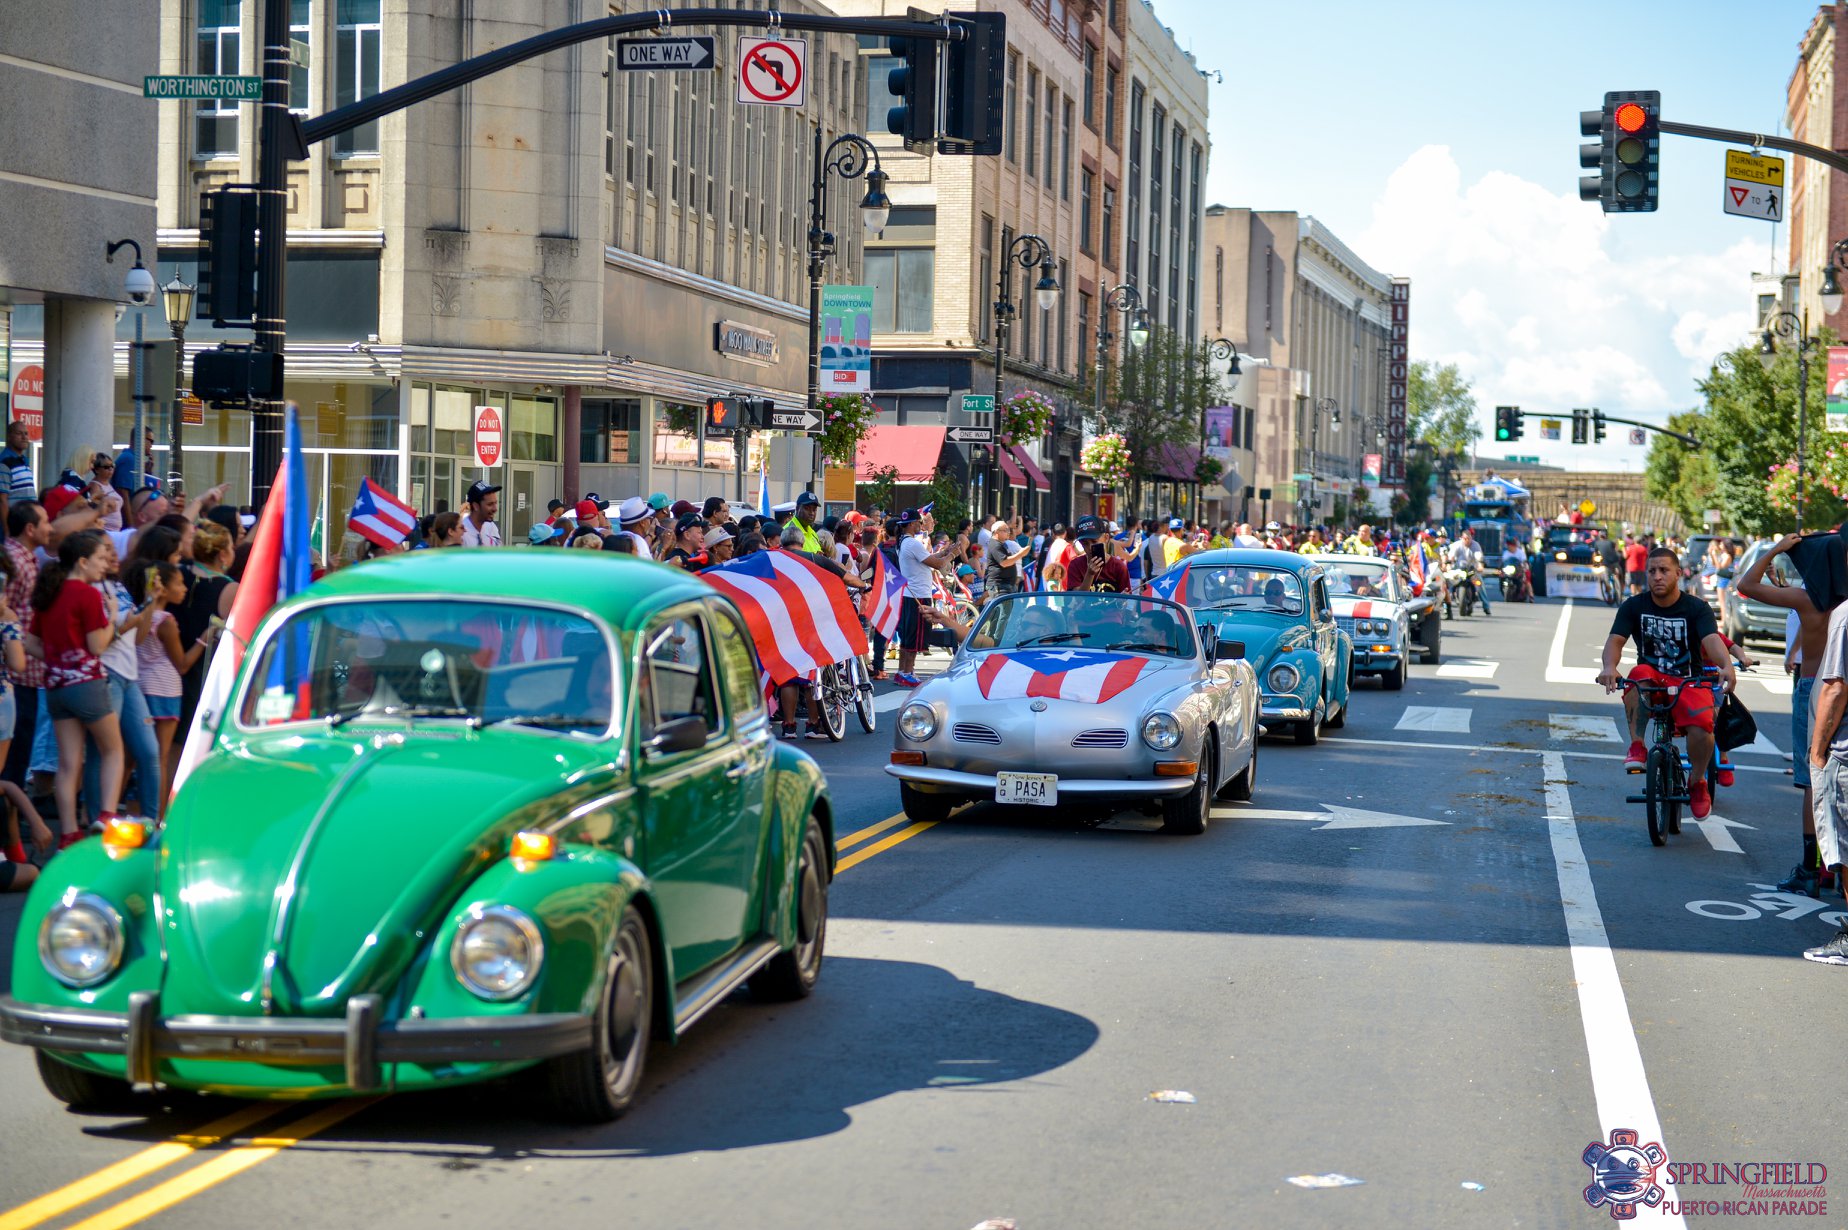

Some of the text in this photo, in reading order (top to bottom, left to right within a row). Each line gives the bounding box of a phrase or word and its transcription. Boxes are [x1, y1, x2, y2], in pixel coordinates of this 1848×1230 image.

[629, 44, 691, 62] ONE WAY
[147, 78, 259, 96] WORTHINGTON ST
[1731, 155, 1765, 168] TURNING
[1729, 166, 1766, 180] VEHICLES
[1751, 196, 1760, 205] TO
[824, 300, 871, 308] DOWNTOWN
[17, 379, 43, 392] DO NO
[963, 399, 994, 408] Fort St
[20, 413, 43, 427] ENTE
[480, 419, 498, 429] DO NOT
[773, 415, 803, 425] NE WAY
[481, 445, 496, 455] ENTER
[1645, 618, 1684, 641] JUST
[1015, 781, 1046, 797] PASA
